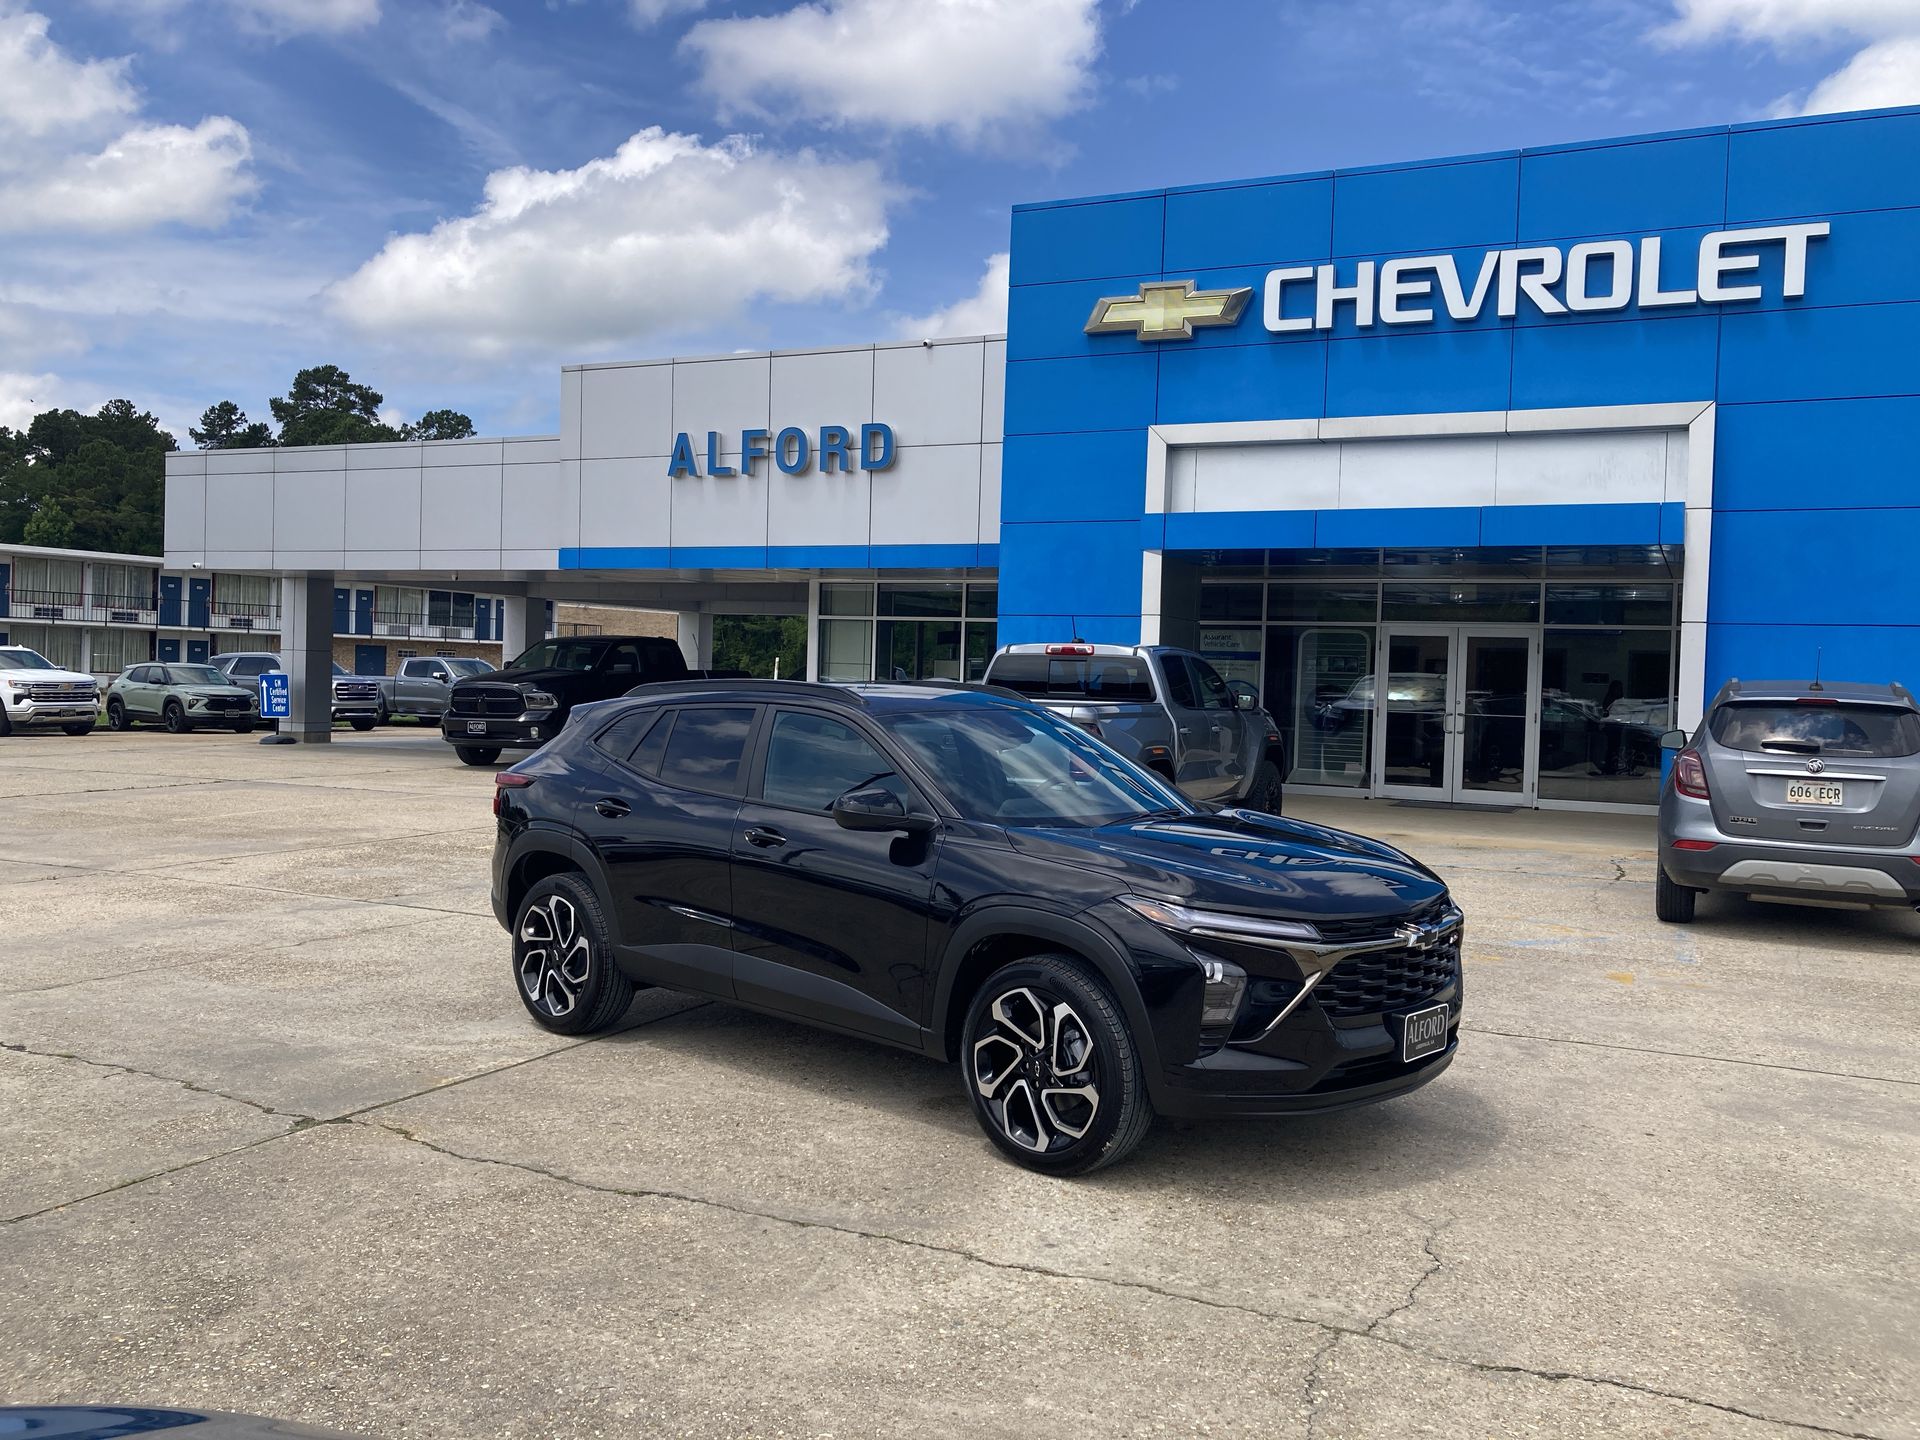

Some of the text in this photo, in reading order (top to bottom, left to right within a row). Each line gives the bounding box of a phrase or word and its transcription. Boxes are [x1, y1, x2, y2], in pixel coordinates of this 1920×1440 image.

[1263, 221, 1831, 333] CHEVROLET
[667, 422, 897, 478] ALFORD
[1204, 633, 1232, 641] Assurant
[269, 687, 288, 696] Certified
[271, 696, 287, 704] Service
[272, 704, 286, 713] Center
[1790, 786, 1841, 800] 606 ECR
[1407, 1014, 1445, 1046] ALFORD
